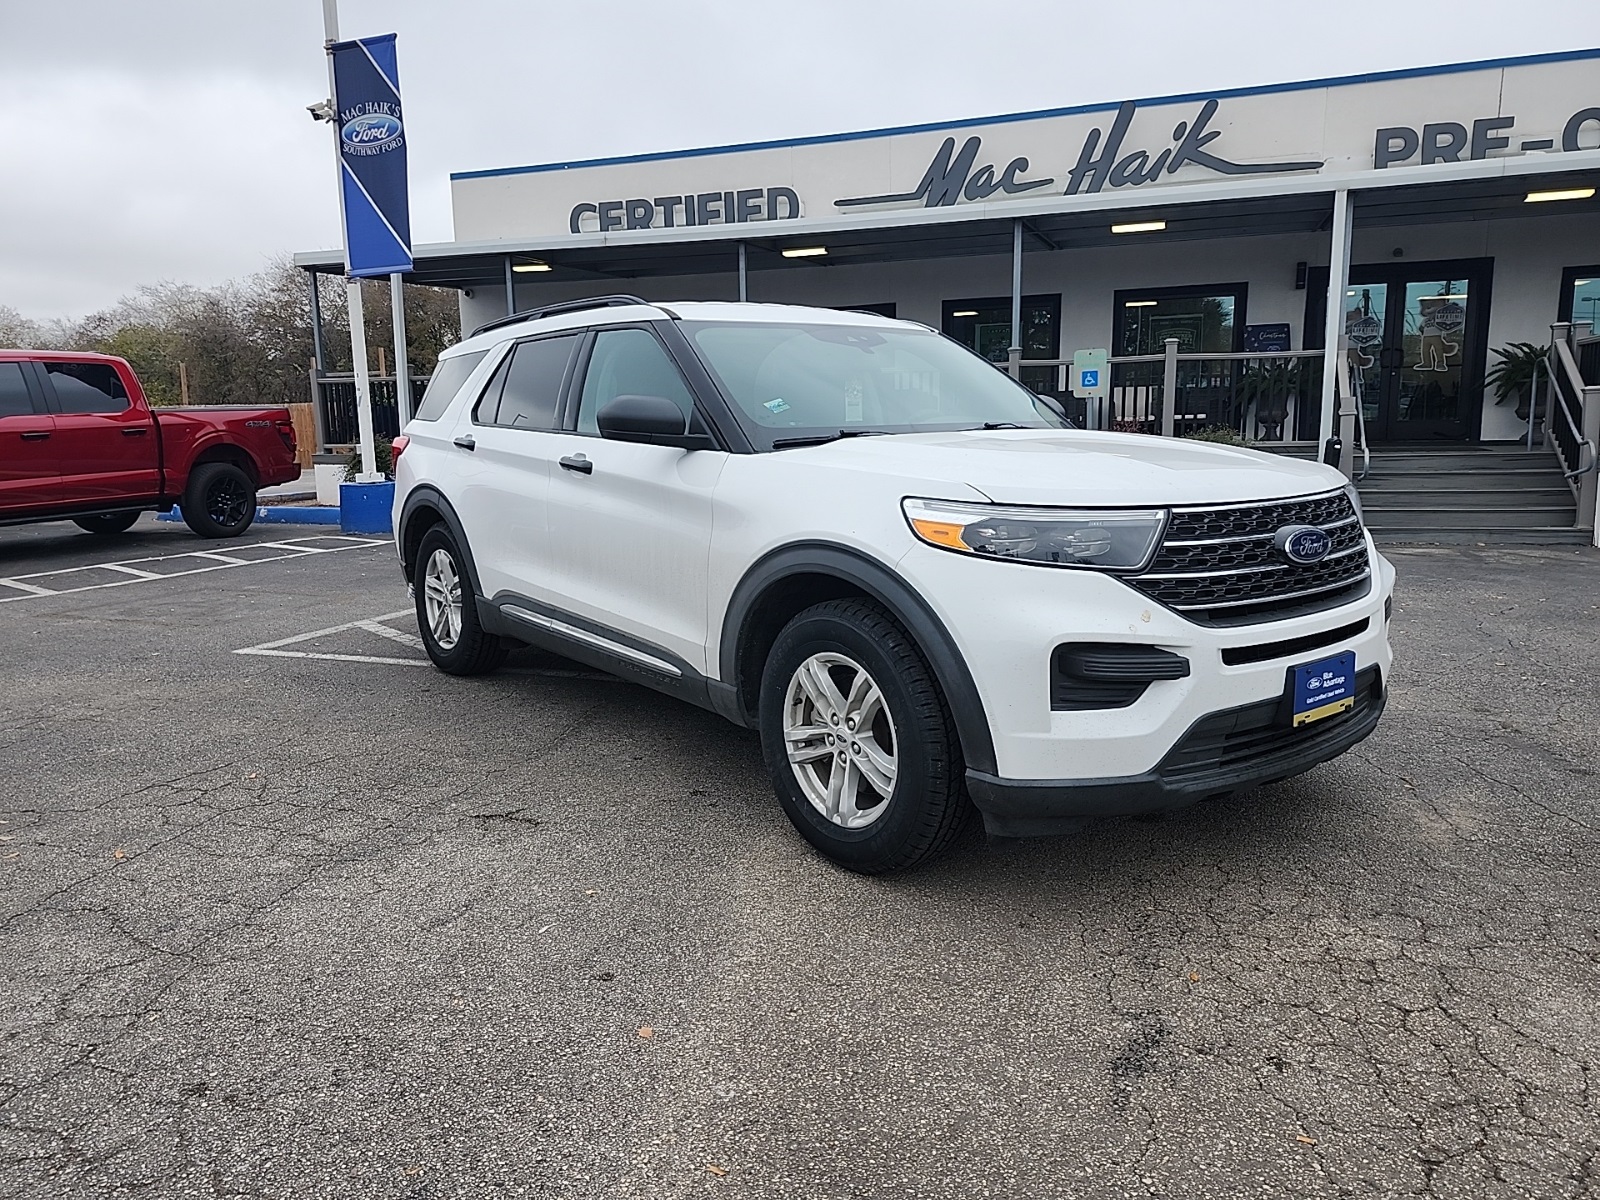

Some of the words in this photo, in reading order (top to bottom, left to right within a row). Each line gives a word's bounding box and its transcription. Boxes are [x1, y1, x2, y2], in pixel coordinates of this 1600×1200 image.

[341, 104, 363, 124] MAC
[365, 102, 400, 117] HAIK'S
[352, 119, 389, 143] Ford
[343, 143, 381, 156] SOUTHWAY
[381, 137, 403, 153] FORD
[834, 136, 1054, 208] Mac
[1063, 100, 1324, 197] Haik
[569, 187, 800, 234] CERTIFIED
[1300, 535, 1324, 555] Ford
[1323, 672, 1334, 680] Blue
[1323, 676, 1345, 688] Advantage
